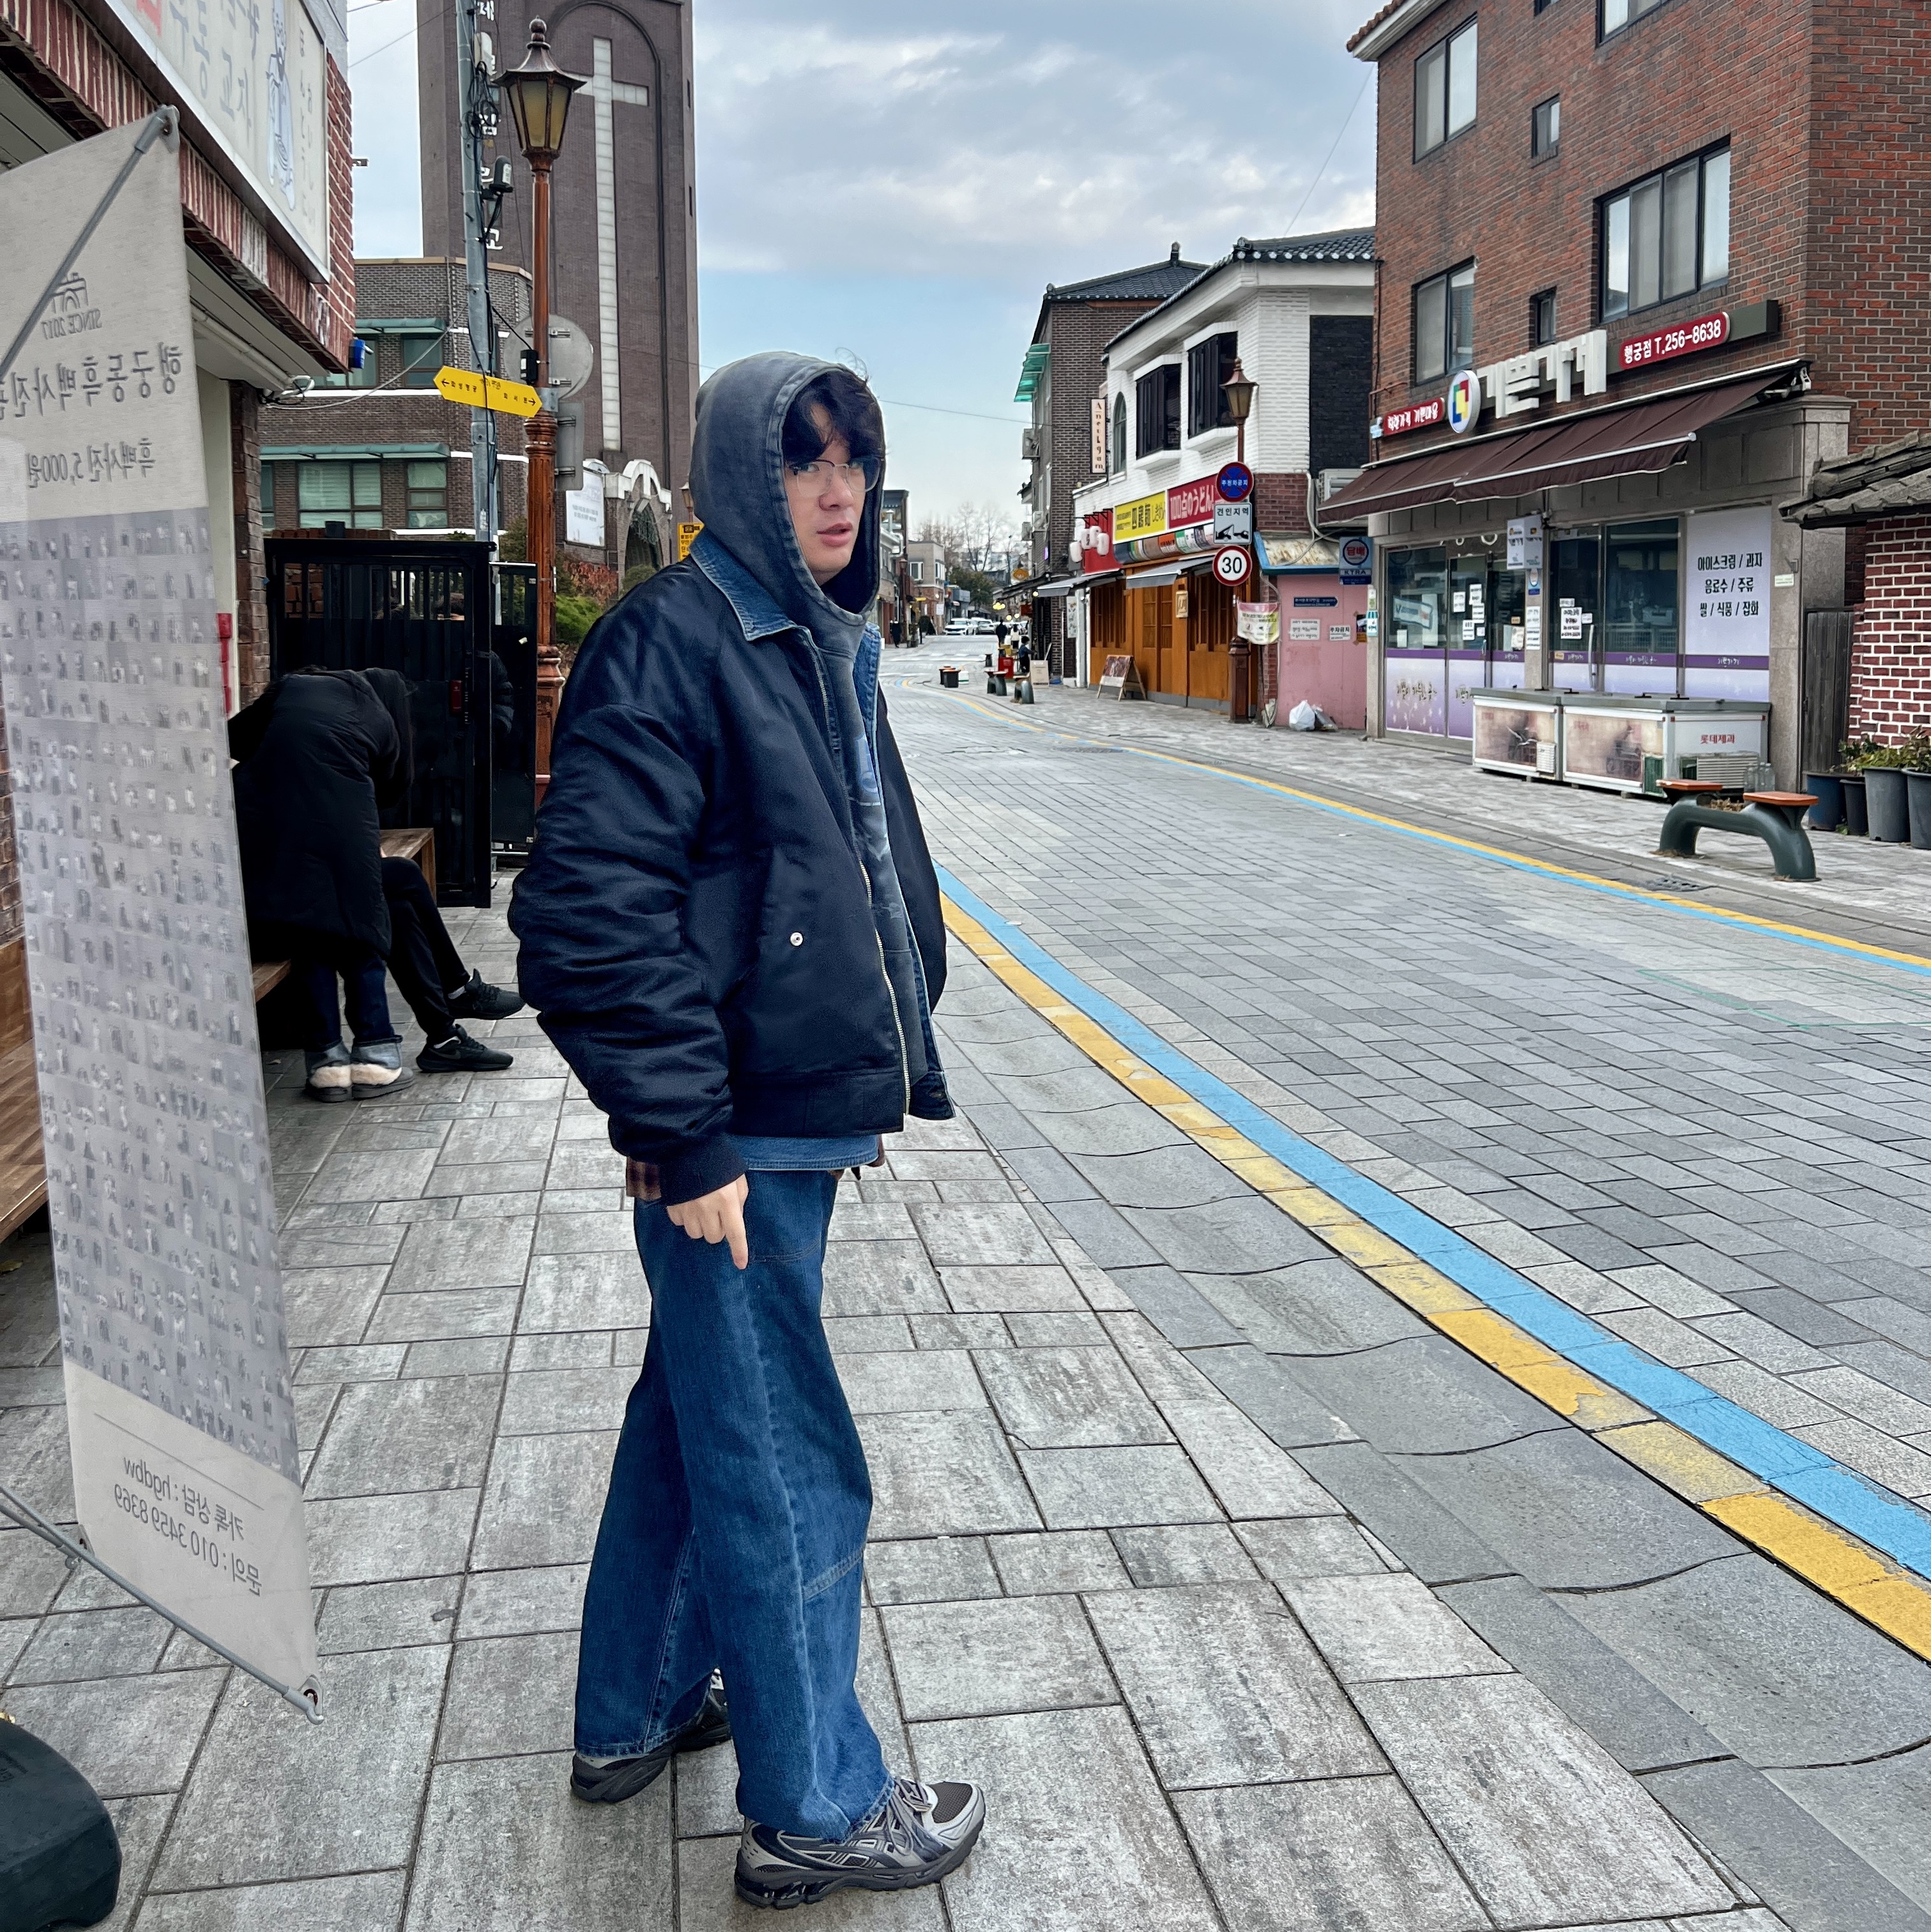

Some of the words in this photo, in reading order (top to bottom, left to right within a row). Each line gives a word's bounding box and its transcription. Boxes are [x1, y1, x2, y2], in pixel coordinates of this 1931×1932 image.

[1624, 338, 1651, 363] 행궁점
[1654, 319, 1721, 354] T.256-8638
[1477, 329, 1607, 419] 기쁜가게
[1387, 411, 1411, 430] 착한가격
[1414, 402, 1439, 423] 기쁜마음
[1217, 507, 1249, 517] 견인지역
[1347, 546, 1365, 557] 담배
[1222, 557, 1242, 574] 30
[1698, 554, 1736, 570] 아이스크림
[1746, 552, 1762, 567] 과자
[1706, 579, 1728, 594] 음료수
[1738, 577, 1753, 592] 주류
[1700, 602, 1707, 617] 쌀
[1717, 602, 1732, 616] 식품
[1743, 600, 1759, 616] 잡화
